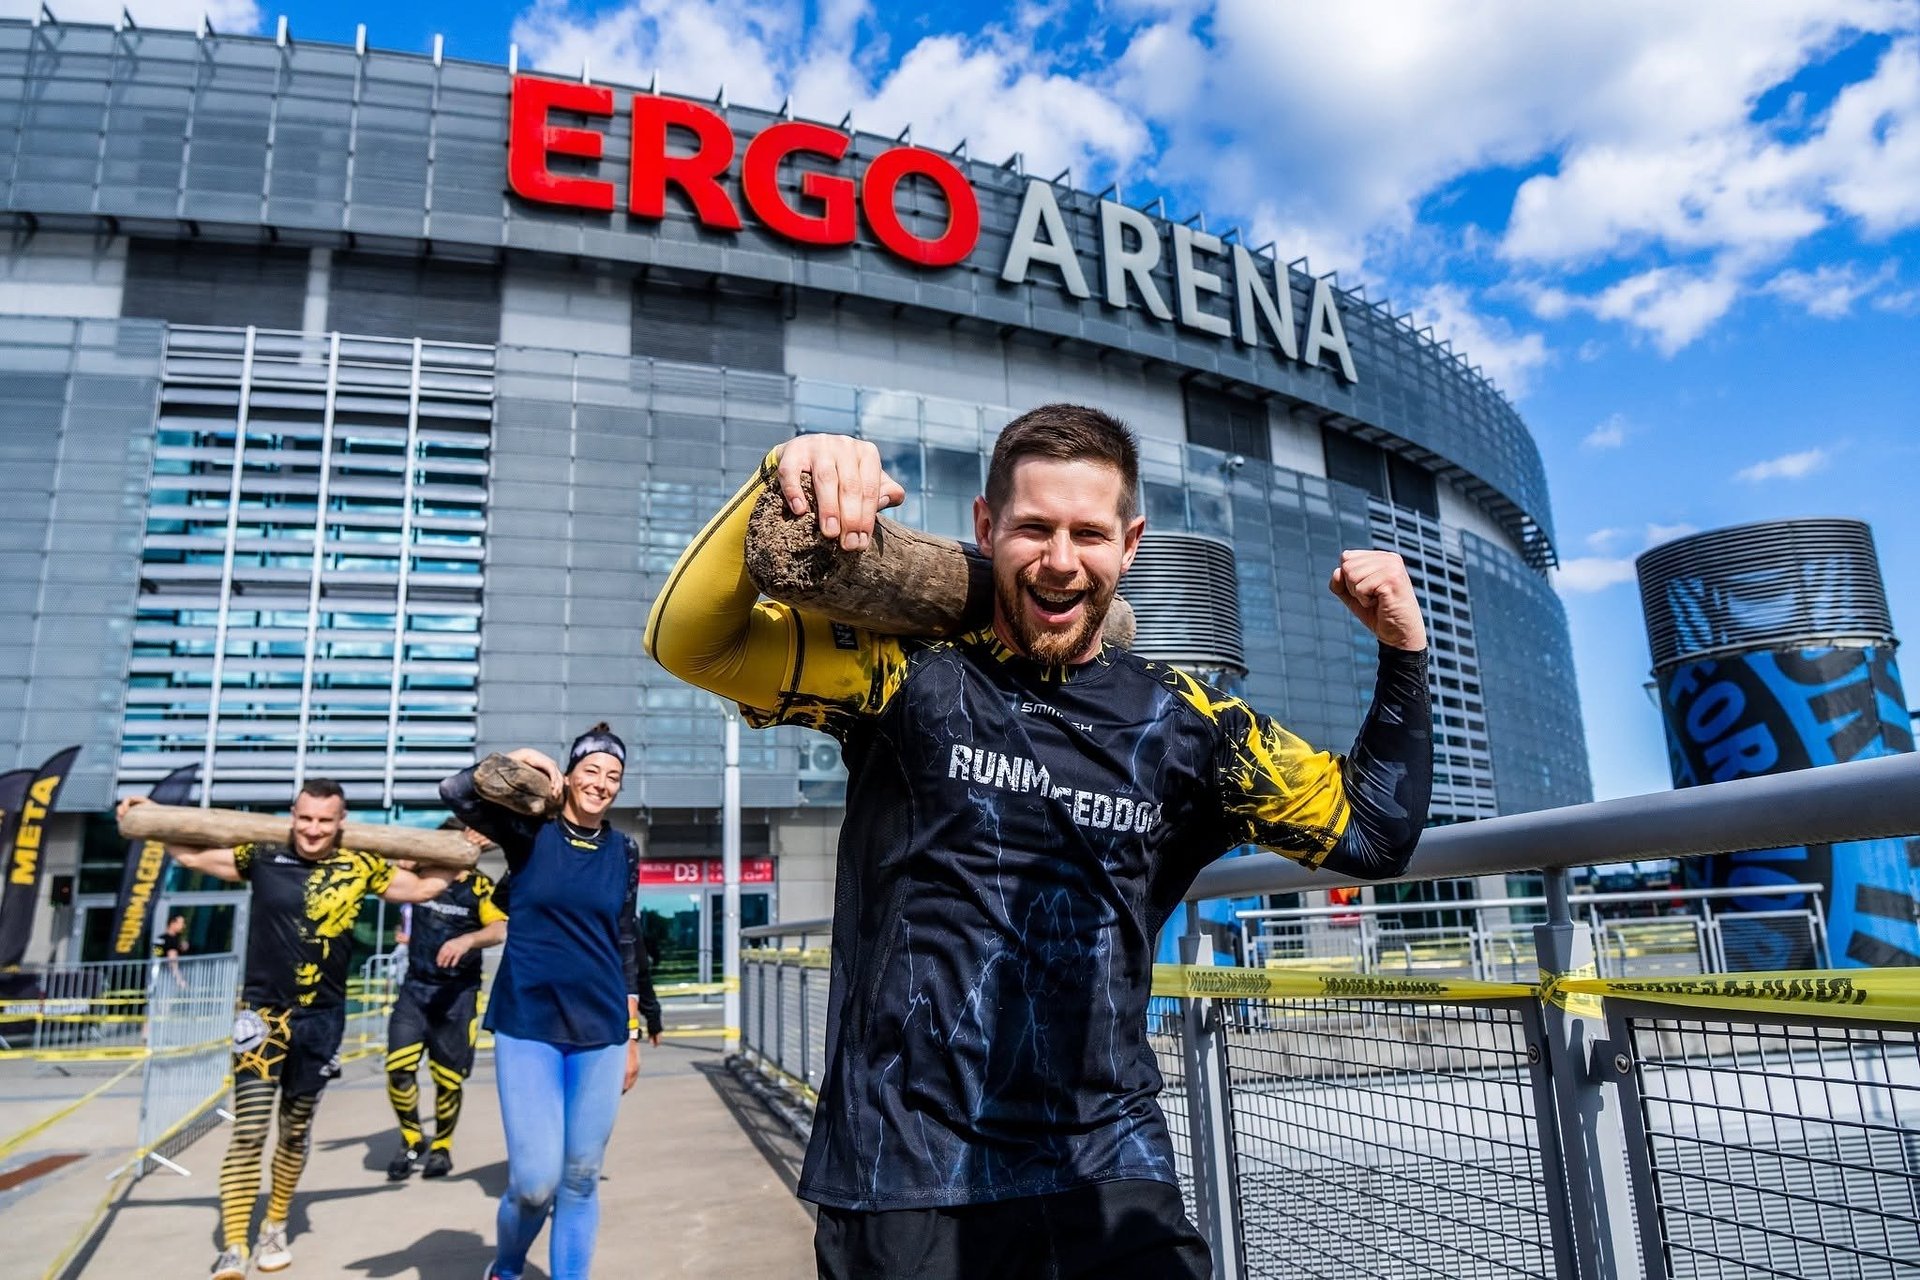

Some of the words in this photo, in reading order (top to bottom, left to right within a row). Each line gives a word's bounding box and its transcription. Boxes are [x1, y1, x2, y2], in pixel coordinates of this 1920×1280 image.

[508, 74, 981, 267] ERGO
[1001, 179, 1359, 384] ARENA
[11, 775, 60, 885] META
[674, 863, 699, 881] D3
